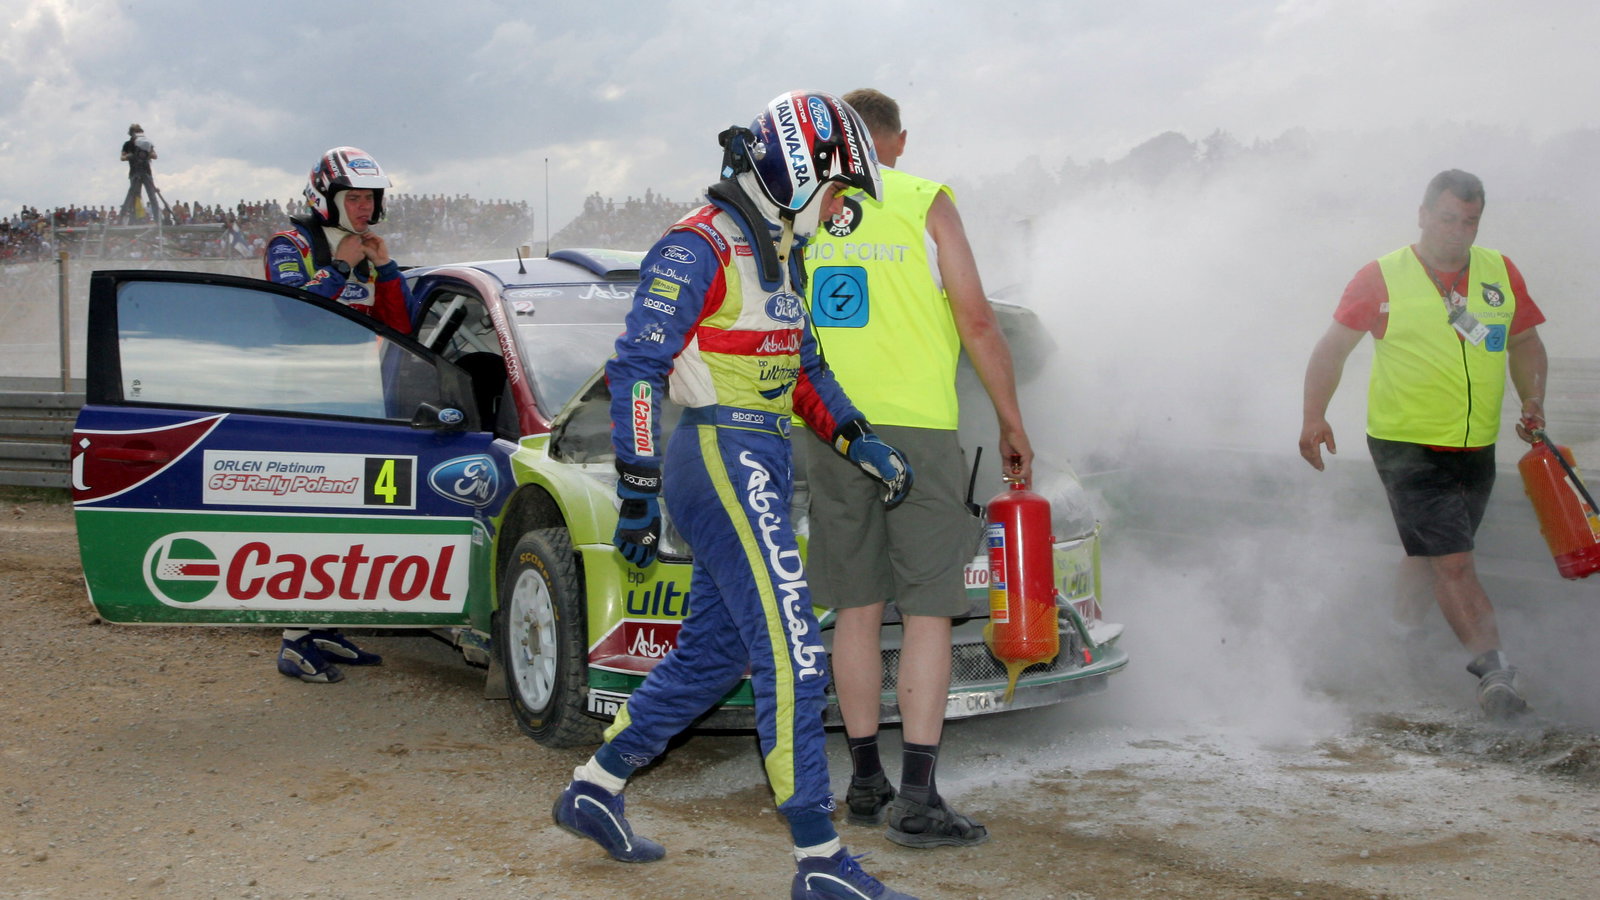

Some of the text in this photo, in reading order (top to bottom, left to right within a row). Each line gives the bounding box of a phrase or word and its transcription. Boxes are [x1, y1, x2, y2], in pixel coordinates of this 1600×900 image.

[810, 102, 828, 131] Ford
[776, 100, 810, 187] TALVIVAARA
[829, 225, 851, 236] PZM
[664, 247, 690, 261] Ford
[844, 243, 909, 262] POINT
[643, 297, 676, 313] sparco
[635, 400, 652, 453] Castrol
[732, 411, 765, 424] sparco
[213, 460, 325, 474] ORLEN Platinum
[243, 474, 291, 496] Rally
[290, 477, 360, 495] Poland
[374, 459, 397, 503] 4
[226, 541, 456, 601] Castrol
[627, 568, 645, 587] bp
